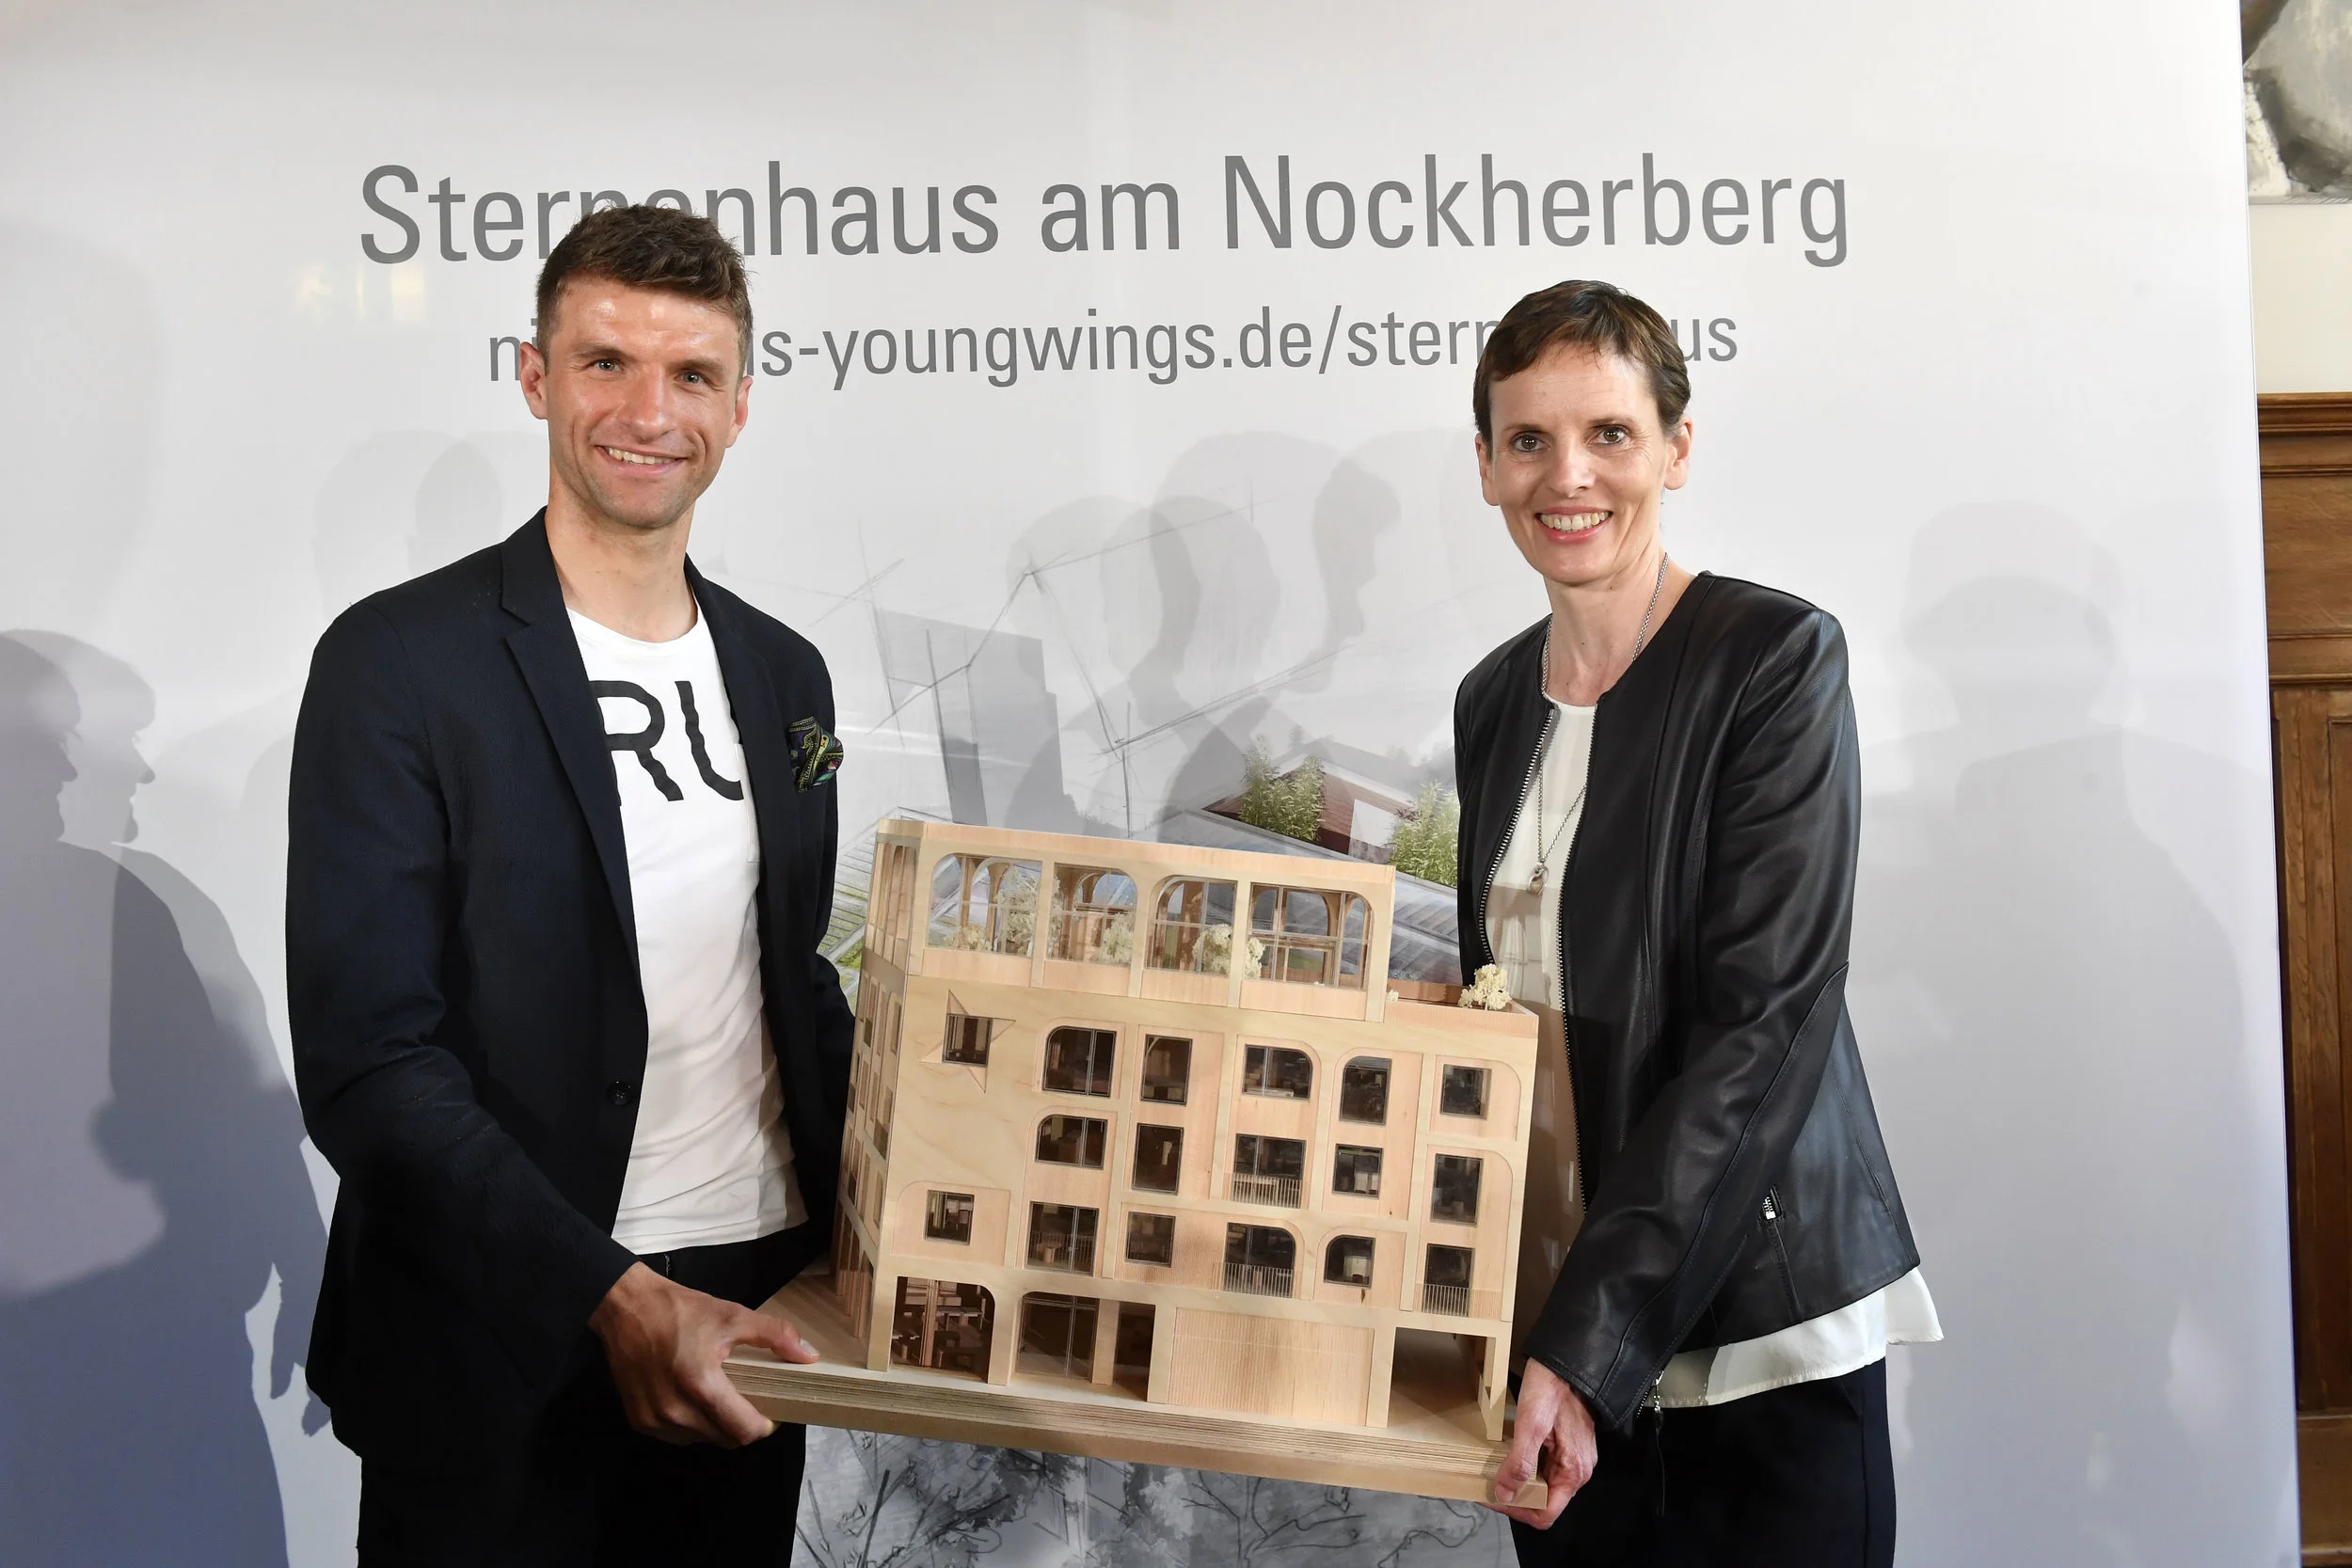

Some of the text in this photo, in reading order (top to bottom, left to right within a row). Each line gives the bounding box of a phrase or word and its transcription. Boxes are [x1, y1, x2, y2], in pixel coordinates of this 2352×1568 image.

[360, 152, 1848, 268] Sternhaus am Nockherberg
